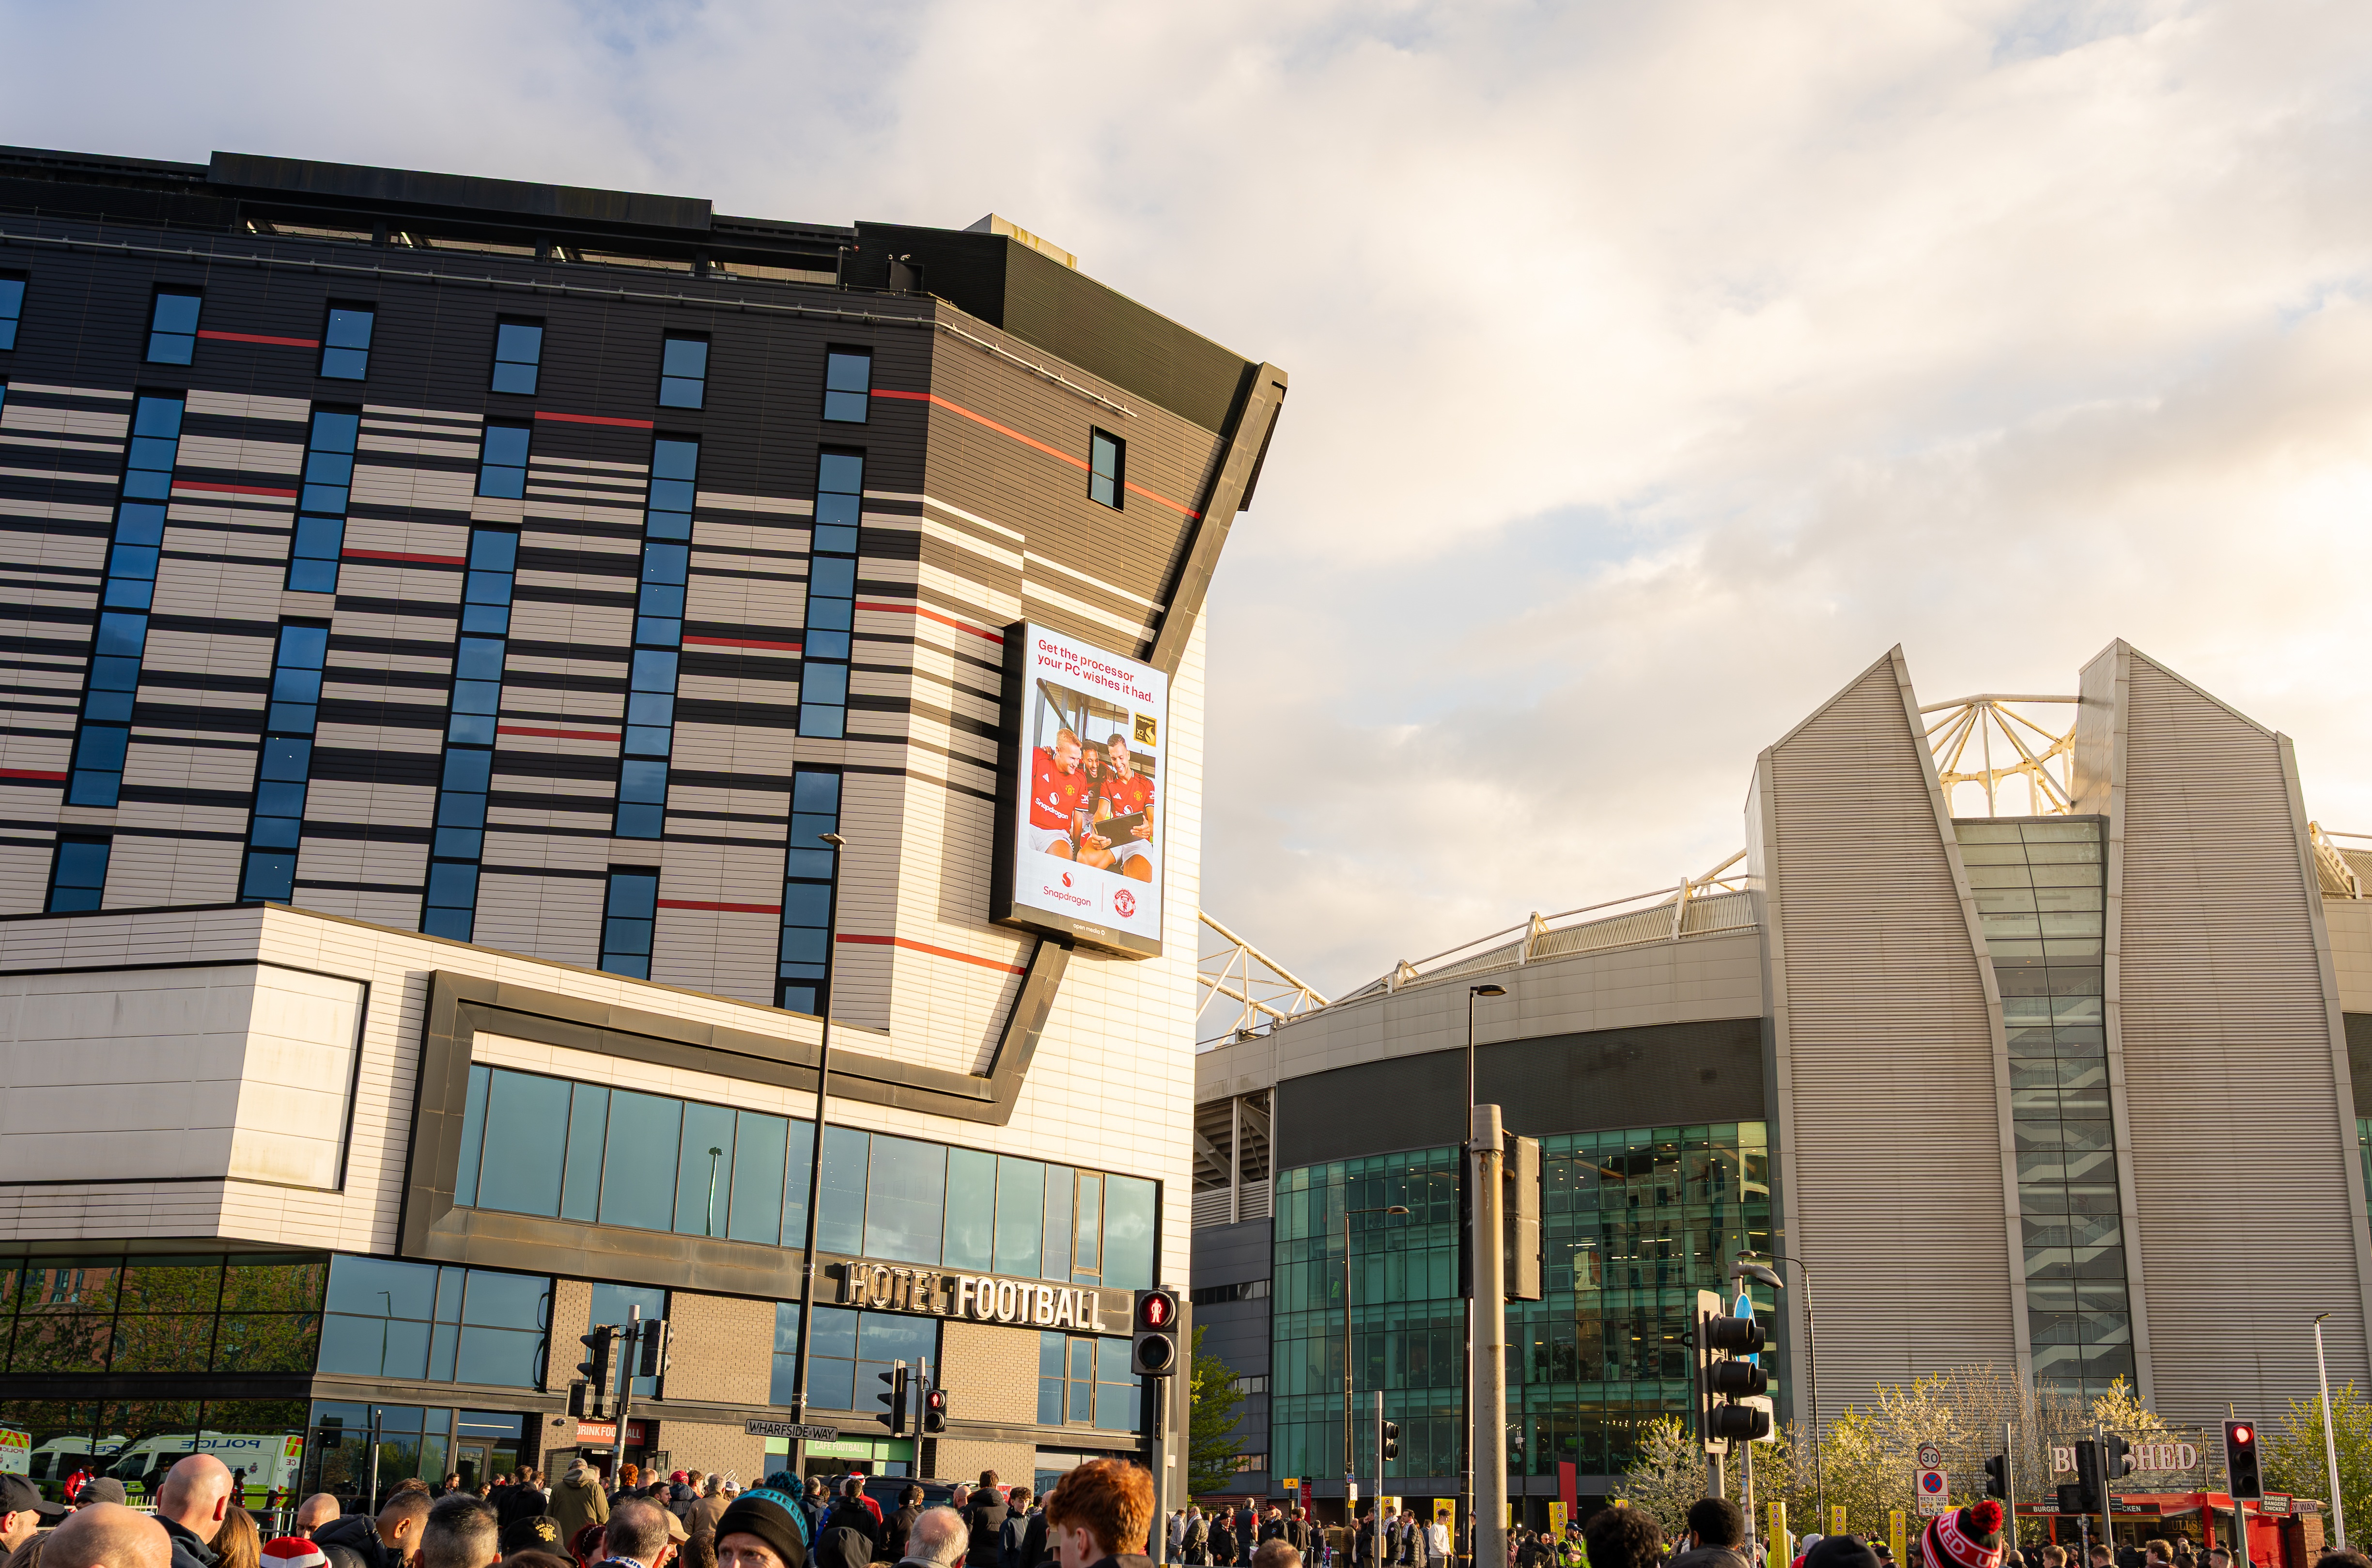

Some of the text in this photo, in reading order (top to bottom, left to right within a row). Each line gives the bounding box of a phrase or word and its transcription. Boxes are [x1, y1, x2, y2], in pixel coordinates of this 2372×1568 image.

[1039, 639, 1134, 682] Get the processor
[1038, 654, 1154, 703] your PC wishes it had.
[1137, 728, 1144, 736] X2
[1035, 797, 1069, 820] Snapdragon
[1043, 885, 1091, 907] Snapdragon
[1086, 926, 1100, 935] media
[845, 1260, 1106, 1331] HOTEL FOOTBALL
[601, 1427, 641, 1439] FOOALL
[749, 1421, 834, 1440] WHARFSIDE WAY
[833, 1442, 864, 1453] FOOTBALL
[1922, 1453, 1938, 1463] 30
